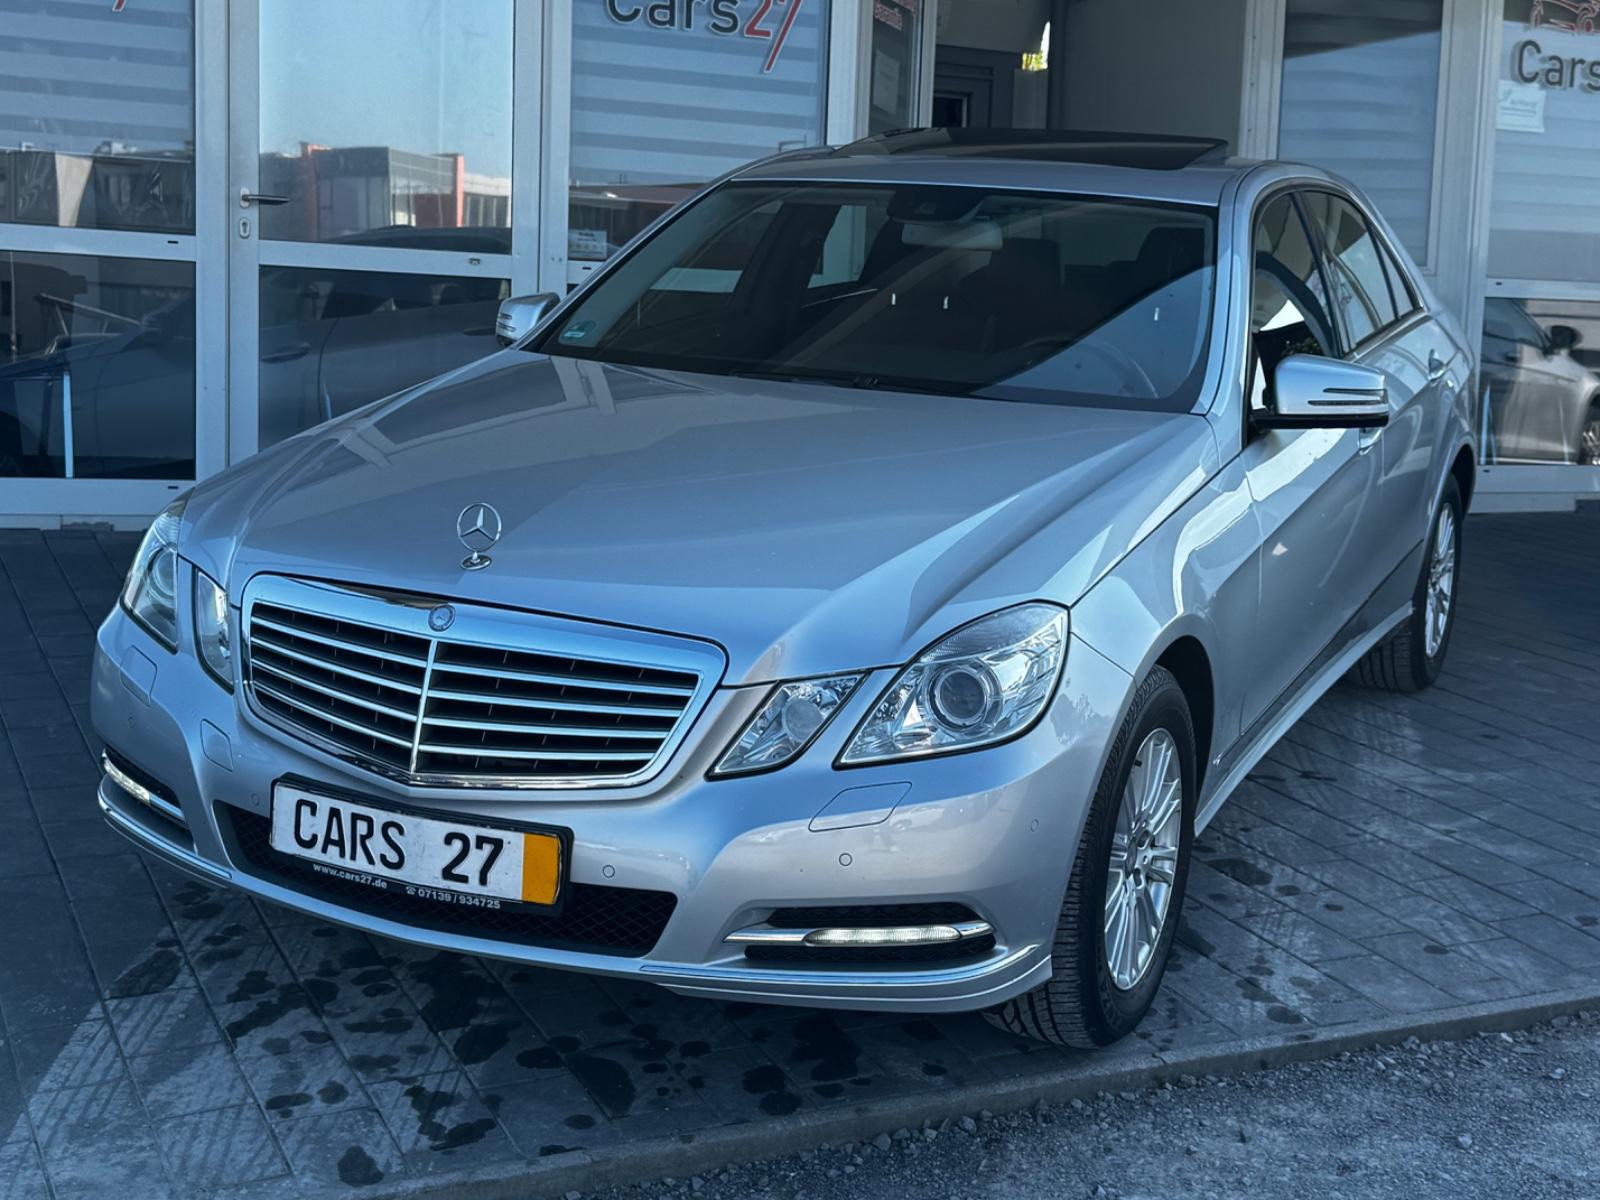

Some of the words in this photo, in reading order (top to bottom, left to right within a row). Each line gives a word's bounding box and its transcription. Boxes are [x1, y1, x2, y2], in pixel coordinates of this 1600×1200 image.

[1516, 39, 1600, 91] Cars
[294, 799, 405, 870] CARS
[441, 832, 504, 887] 27
[312, 863, 388, 890] www.cars27.de
[418, 889, 451, 902] 07139
[459, 896, 501, 910] 934725
